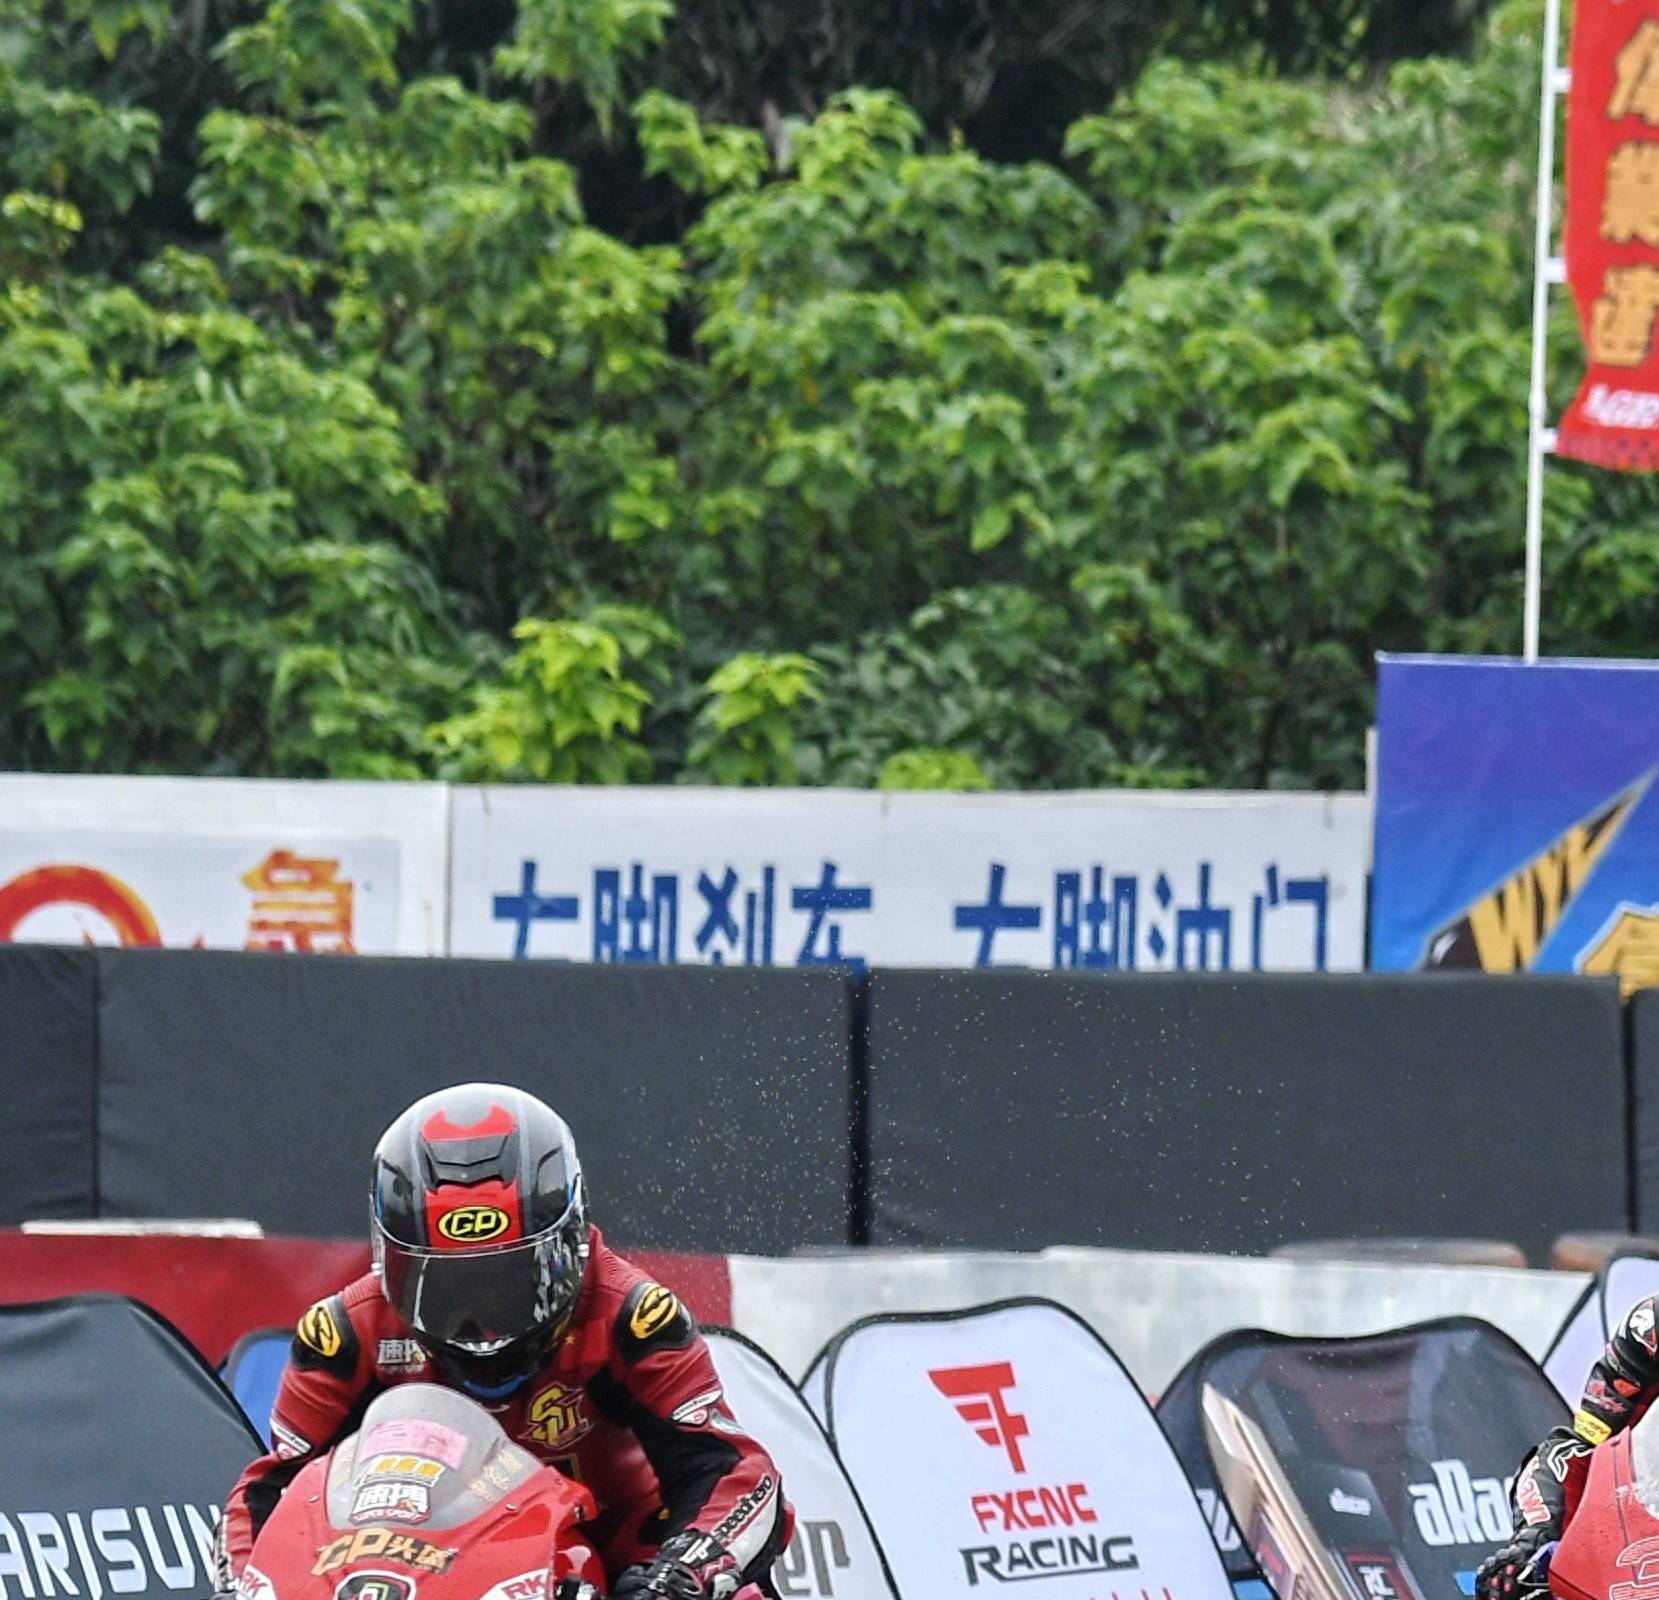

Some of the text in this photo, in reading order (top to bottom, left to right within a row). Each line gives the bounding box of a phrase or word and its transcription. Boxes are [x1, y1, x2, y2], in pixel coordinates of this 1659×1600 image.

[450, 1211, 500, 1236] GP
[971, 1484, 1098, 1534] FXCNC
[959, 1534, 1140, 1586] RACING
